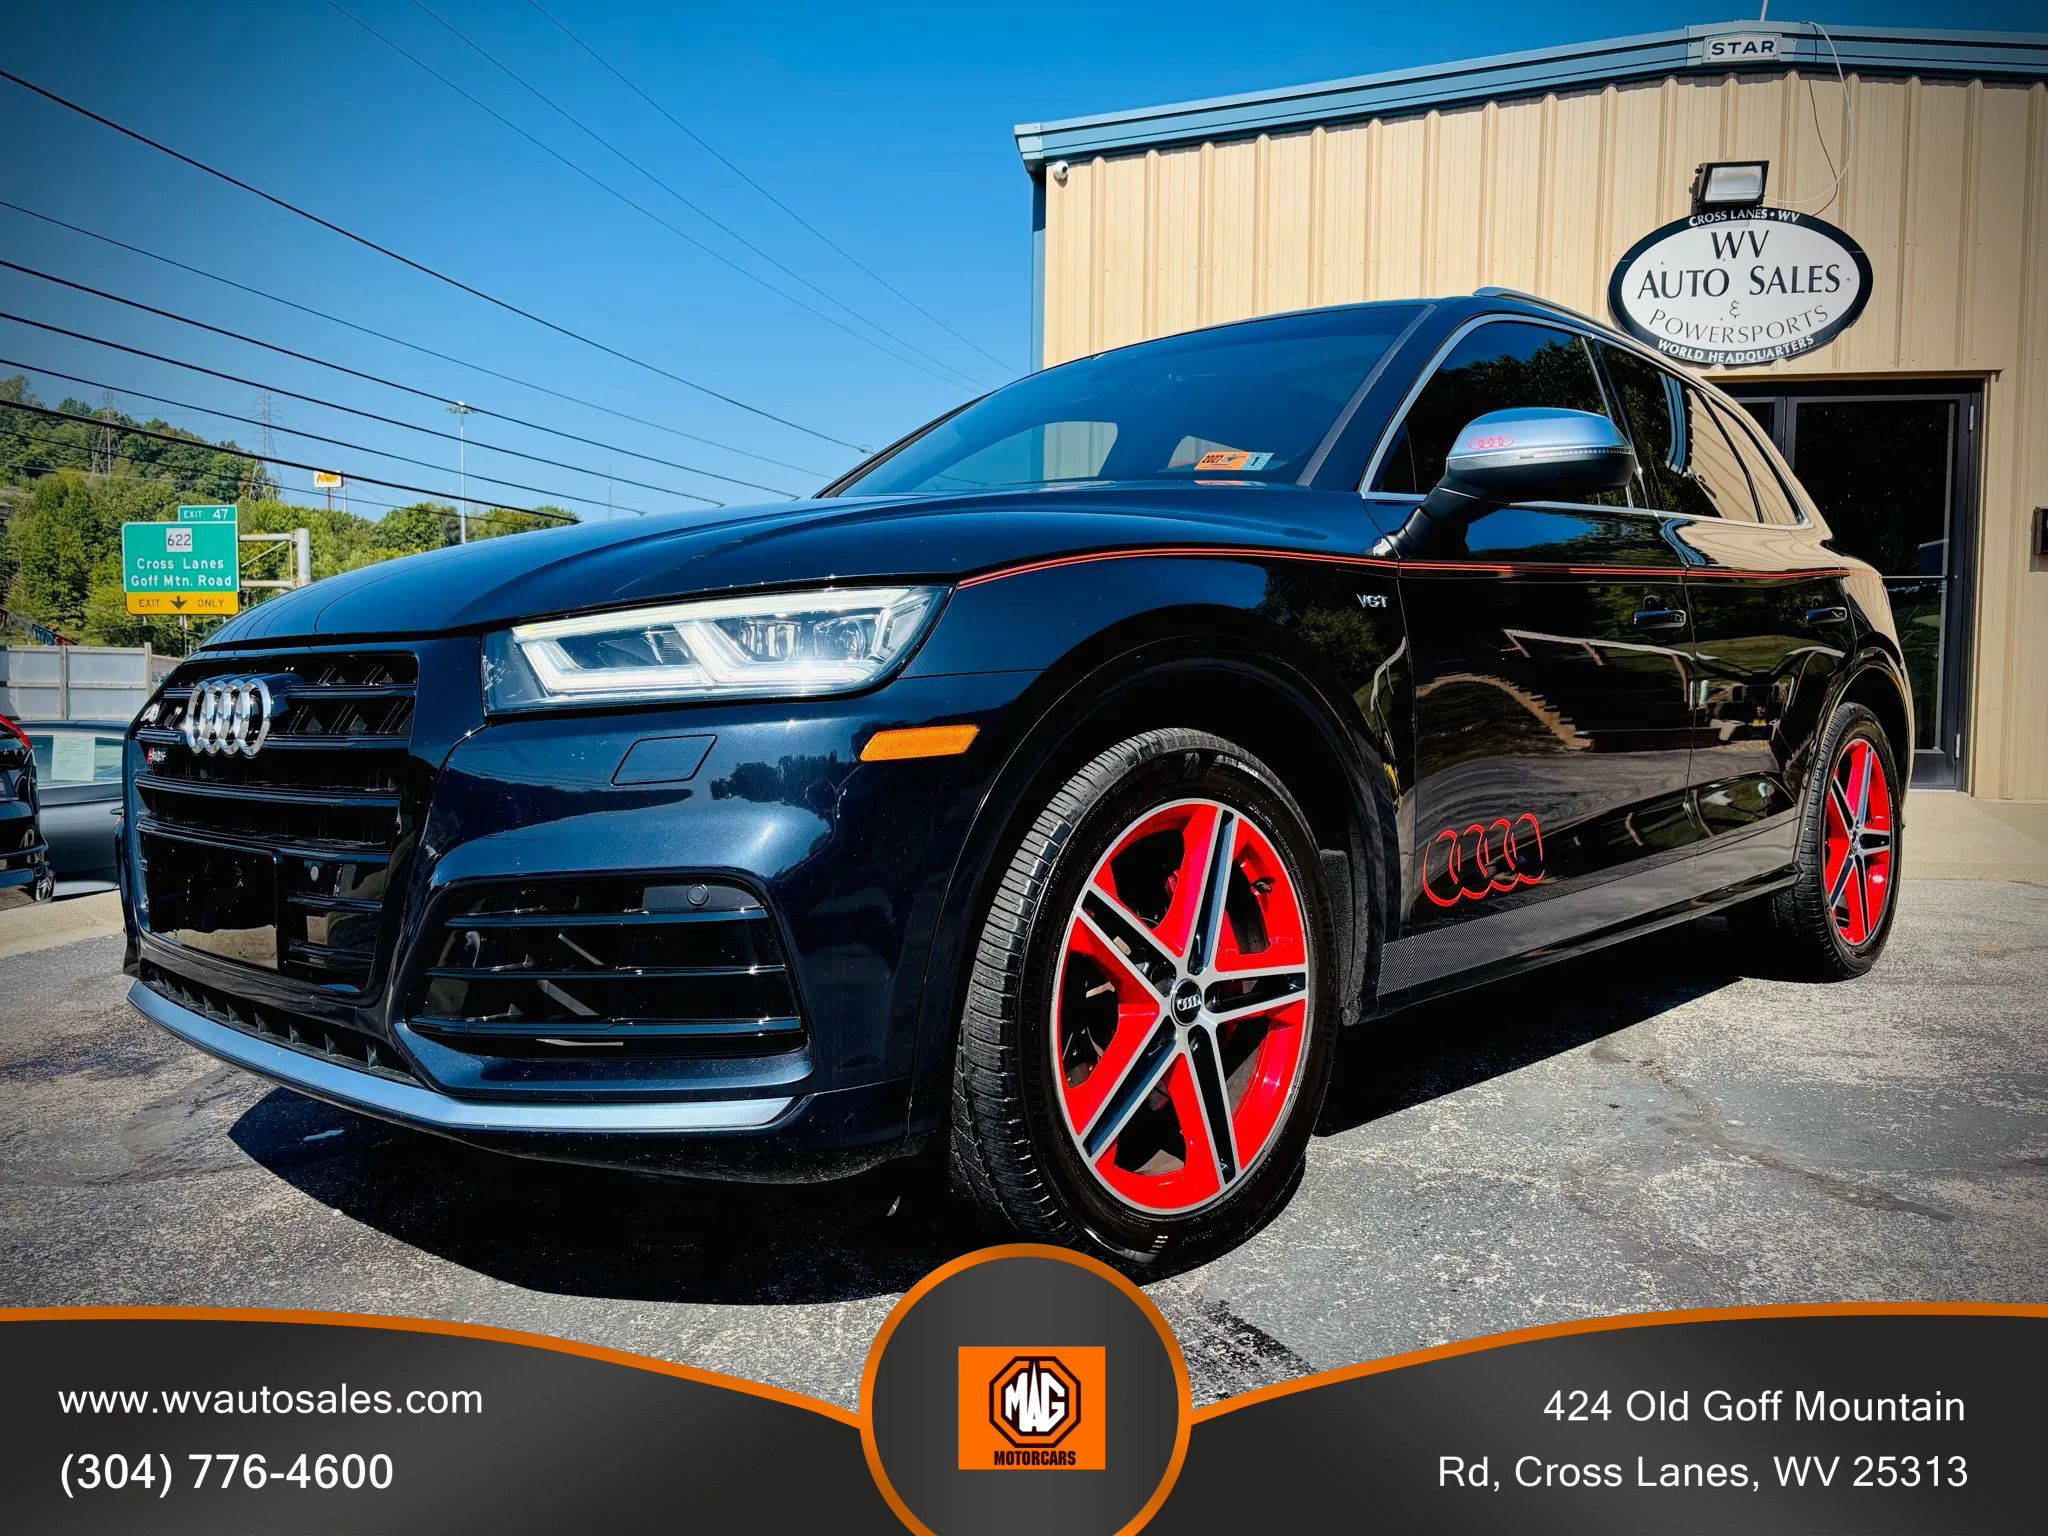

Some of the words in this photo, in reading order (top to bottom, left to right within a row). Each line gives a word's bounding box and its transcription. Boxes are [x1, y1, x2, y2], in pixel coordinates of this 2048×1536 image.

[1711, 40, 1775, 56] STAR
[1689, 209, 1727, 227] CROSS
[1730, 207, 1767, 220] LANES
[1778, 210, 1800, 223] WV
[1710, 229, 1770, 260] WV
[1637, 268, 1730, 300] AUTO
[1749, 264, 1840, 296] SALES
[1729, 300, 1741, 318] &
[1648, 304, 1829, 345] POWERSPORTS
[1657, 338, 1704, 360] WORLD
[1707, 335, 1814, 364] HEADQUARTERS
[183, 510, 202, 519] EXIT
[212, 508, 229, 520] 47
[167, 533, 192, 547] 622
[136, 558, 174, 570] Cross
[183, 558, 224, 570] Lanes
[131, 575, 158, 587] Goff
[163, 575, 193, 587] Mtn.
[198, 575, 232, 587] Road
[138, 598, 160, 608] EXIT
[197, 598, 224, 608] ONLY
